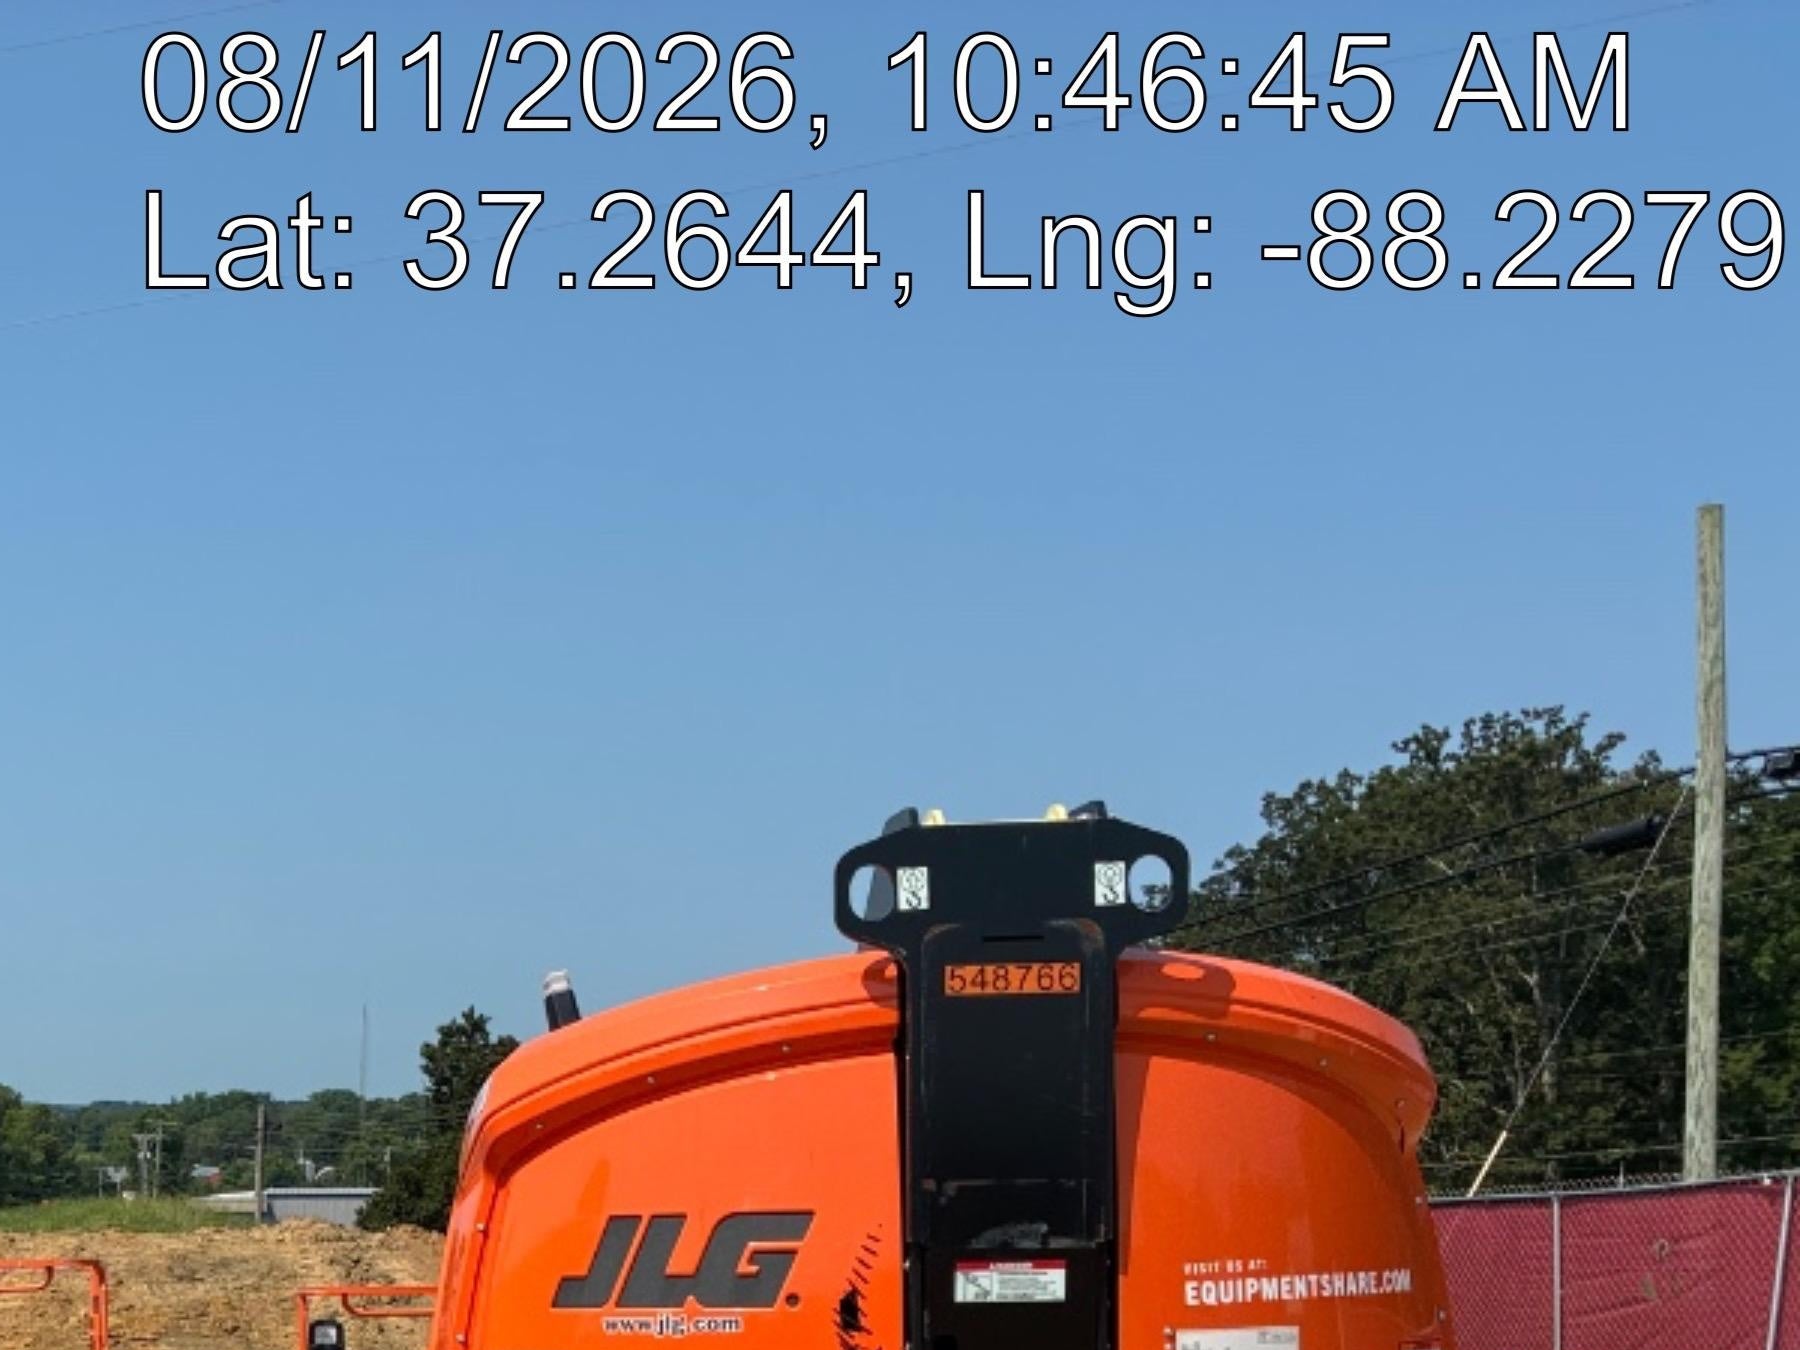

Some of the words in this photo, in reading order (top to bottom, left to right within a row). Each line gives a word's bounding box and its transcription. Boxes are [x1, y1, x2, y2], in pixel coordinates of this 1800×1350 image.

[948, 964, 1078, 993] 548766
[1184, 1262, 1220, 1276] VISIT
[1184, 1269, 1411, 1306] EQUIPMENTSHARE.COM
[602, 1314, 743, 1336] www.jlg.com
